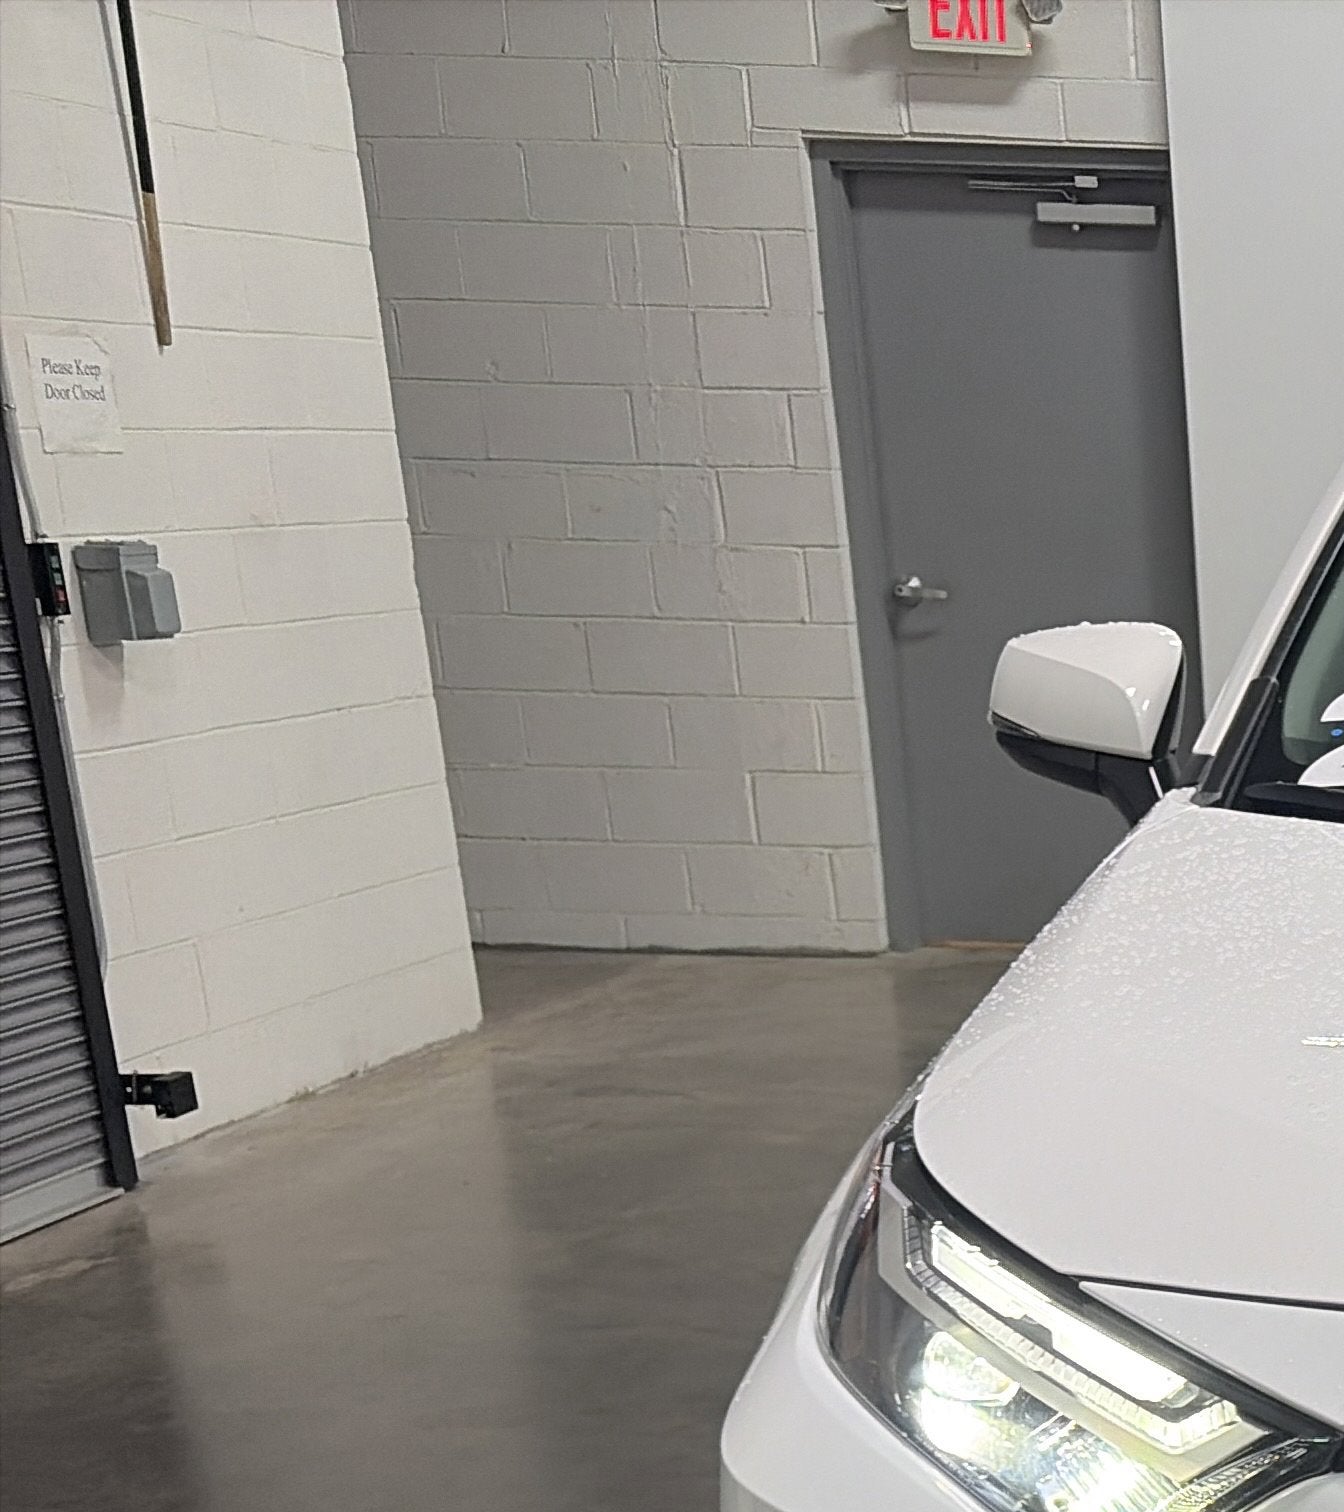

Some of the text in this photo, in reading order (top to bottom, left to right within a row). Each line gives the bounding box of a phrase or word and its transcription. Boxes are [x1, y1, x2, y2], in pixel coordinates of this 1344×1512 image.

[41, 357, 101, 381] Please Keep
[43, 382, 106, 401] Door Closed
